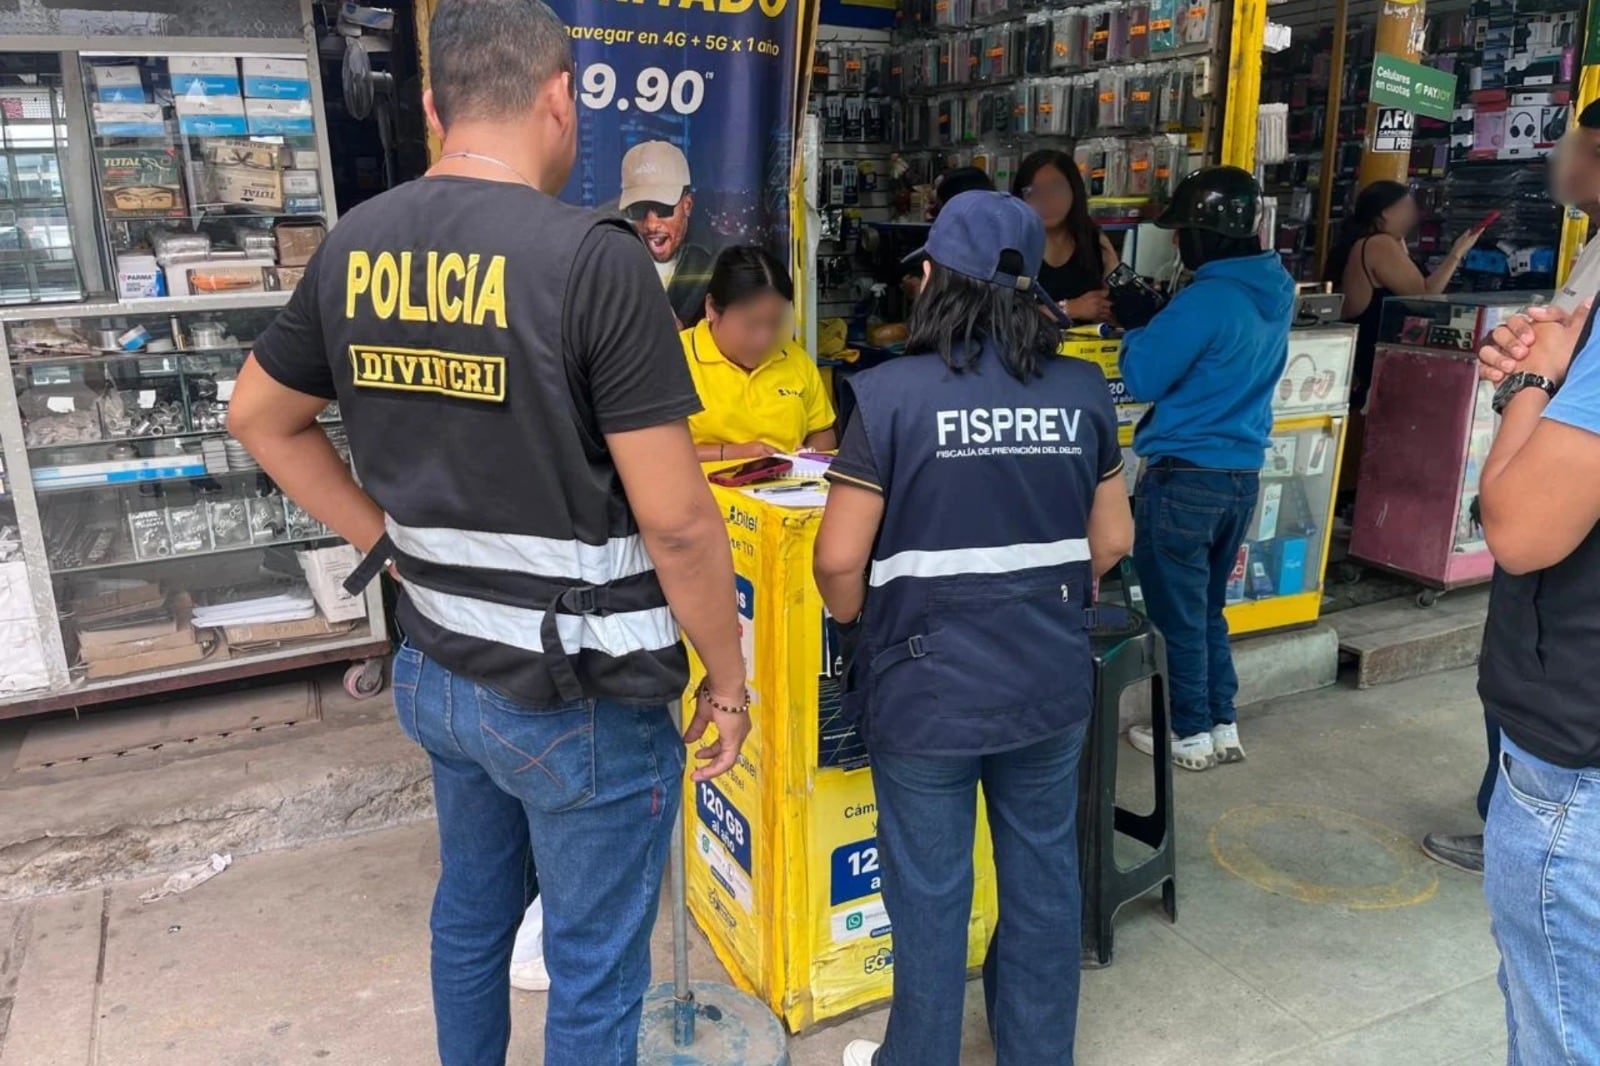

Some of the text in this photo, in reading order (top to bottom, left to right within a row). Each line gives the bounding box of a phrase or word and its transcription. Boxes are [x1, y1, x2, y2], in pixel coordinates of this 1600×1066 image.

[638, 31, 658, 45] en
[663, 31, 686, 46] 4G
[705, 35, 728, 50] 5G
[731, 40, 741, 51] x
[747, 37, 754, 51] 1
[757, 40, 779, 56] año
[574, 62, 705, 114] 9.90
[1375, 80, 1411, 98] en cuotas
[1377, 66, 1410, 84] Celulares
[104, 157, 141, 167] TOTAL
[361, 353, 495, 394] DIVINCRI
[936, 408, 1081, 446] FISPREV
[936, 445, 1082, 458] FISCALÍA DE PREVENCIÓN DEL DELITO
[701, 782, 724, 822] 120
[725, 809, 744, 847] GB
[711, 820, 720, 835] al
[721, 829, 735, 854] año
